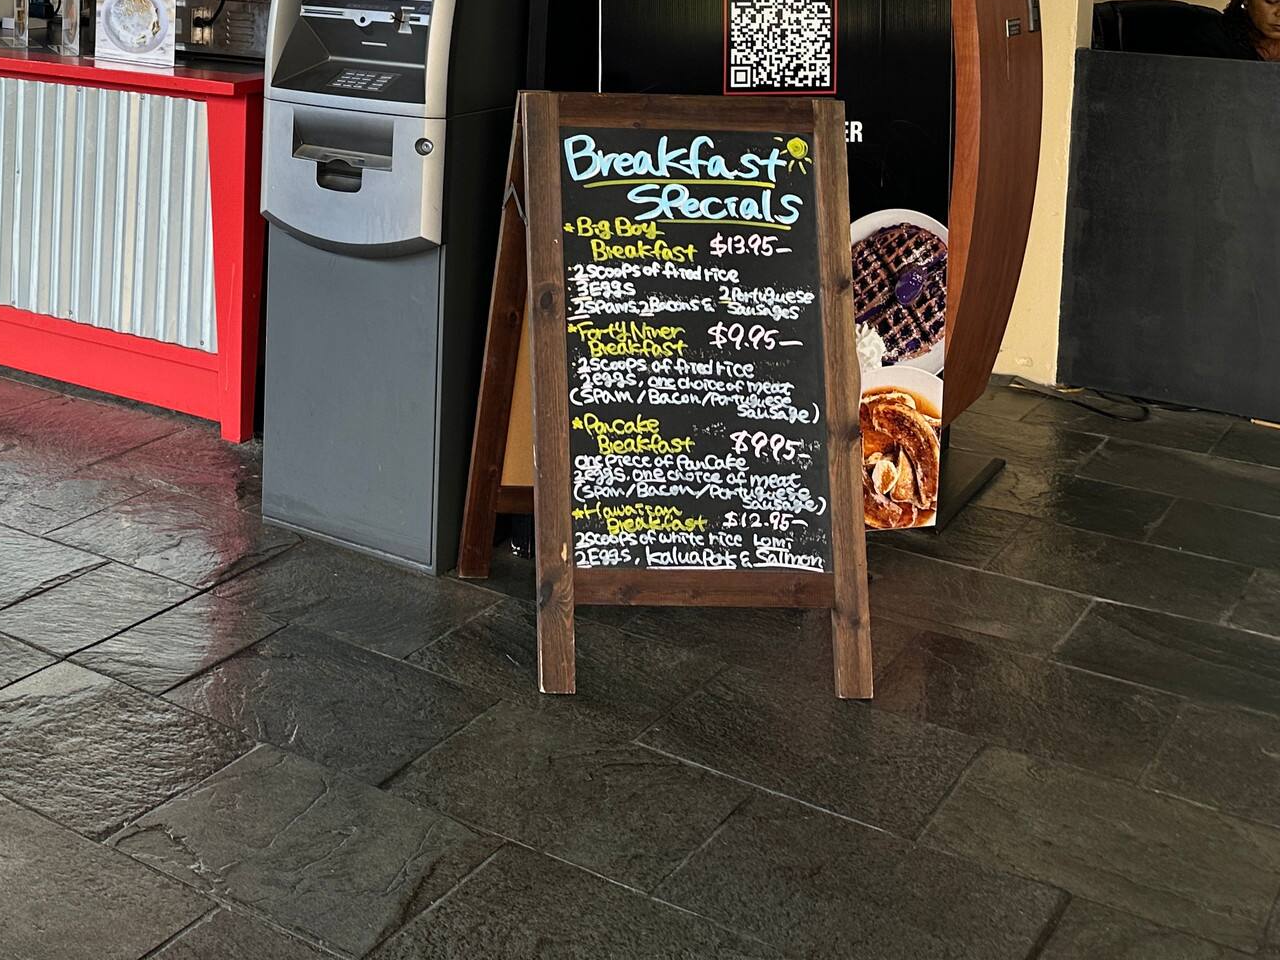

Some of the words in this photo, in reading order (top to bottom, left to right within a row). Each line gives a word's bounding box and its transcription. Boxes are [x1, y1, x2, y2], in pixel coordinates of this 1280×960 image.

[564, 134, 788, 182] Breakfast
[577, 216, 613, 240] Big
[614, 216, 666, 240] Boy
[590, 239, 698, 262] Breakfast
[642, 261, 661, 277] of
[704, 267, 740, 283] rice
[731, 286, 815, 306] Portuguese
[576, 321, 631, 342] Forty
[630, 321, 686, 342] Niner
[587, 339, 689, 358] Breakfast
[651, 357, 673, 375] of
[716, 360, 754, 379] rice
[647, 376, 677, 390] one
[726, 380, 745, 392] of
[747, 380, 795, 396] meat
[583, 412, 660, 437] Pancake
[597, 434, 696, 455] Breakfast
[654, 454, 673, 468] of
[632, 468, 666, 482] one
[726, 471, 748, 485] of
[750, 472, 801, 489] meat
[584, 501, 683, 520] Hawaiian
[607, 514, 707, 535] Breakfast
[639, 530, 657, 545] of
[658, 531, 705, 546] white
[709, 531, 743, 547] rice
[754, 549, 826, 569] Salmon
